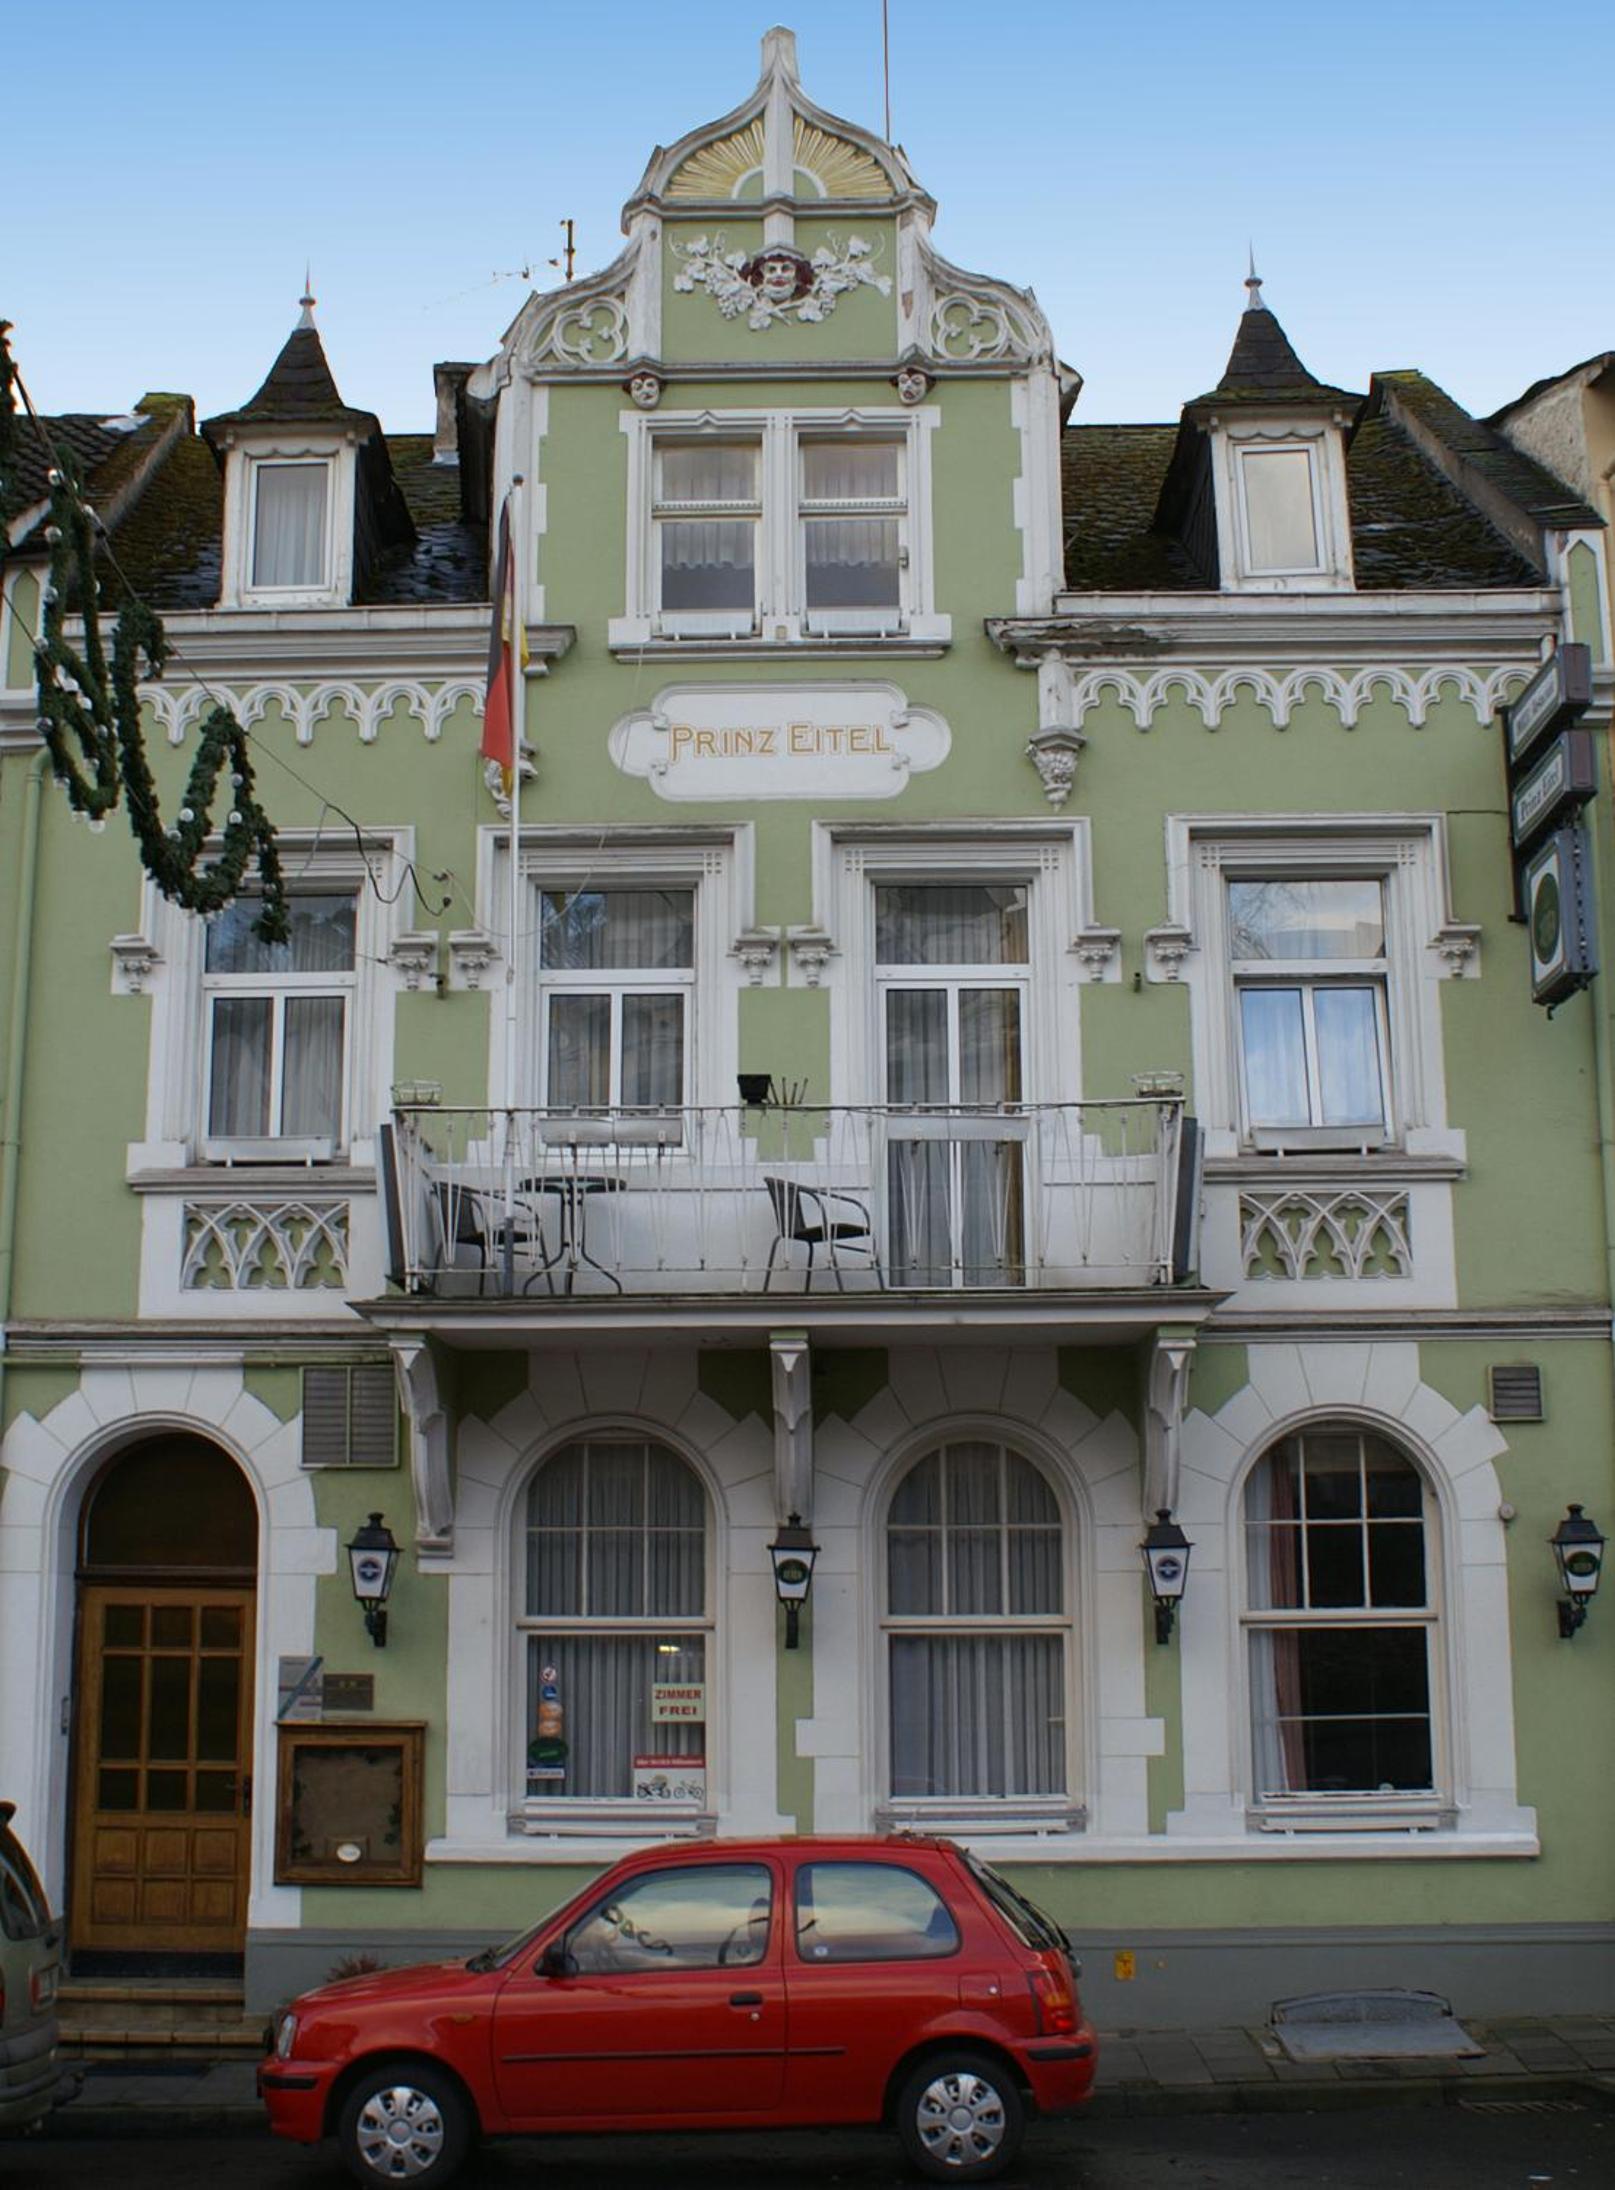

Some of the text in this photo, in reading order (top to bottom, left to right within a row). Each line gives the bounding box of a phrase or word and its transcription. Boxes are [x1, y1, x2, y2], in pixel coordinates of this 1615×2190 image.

[670, 723, 892, 763] PRINZ EITEL
[655, 1689, 702, 1700] ZIMMER
[659, 1705, 697, 1715] FREI
